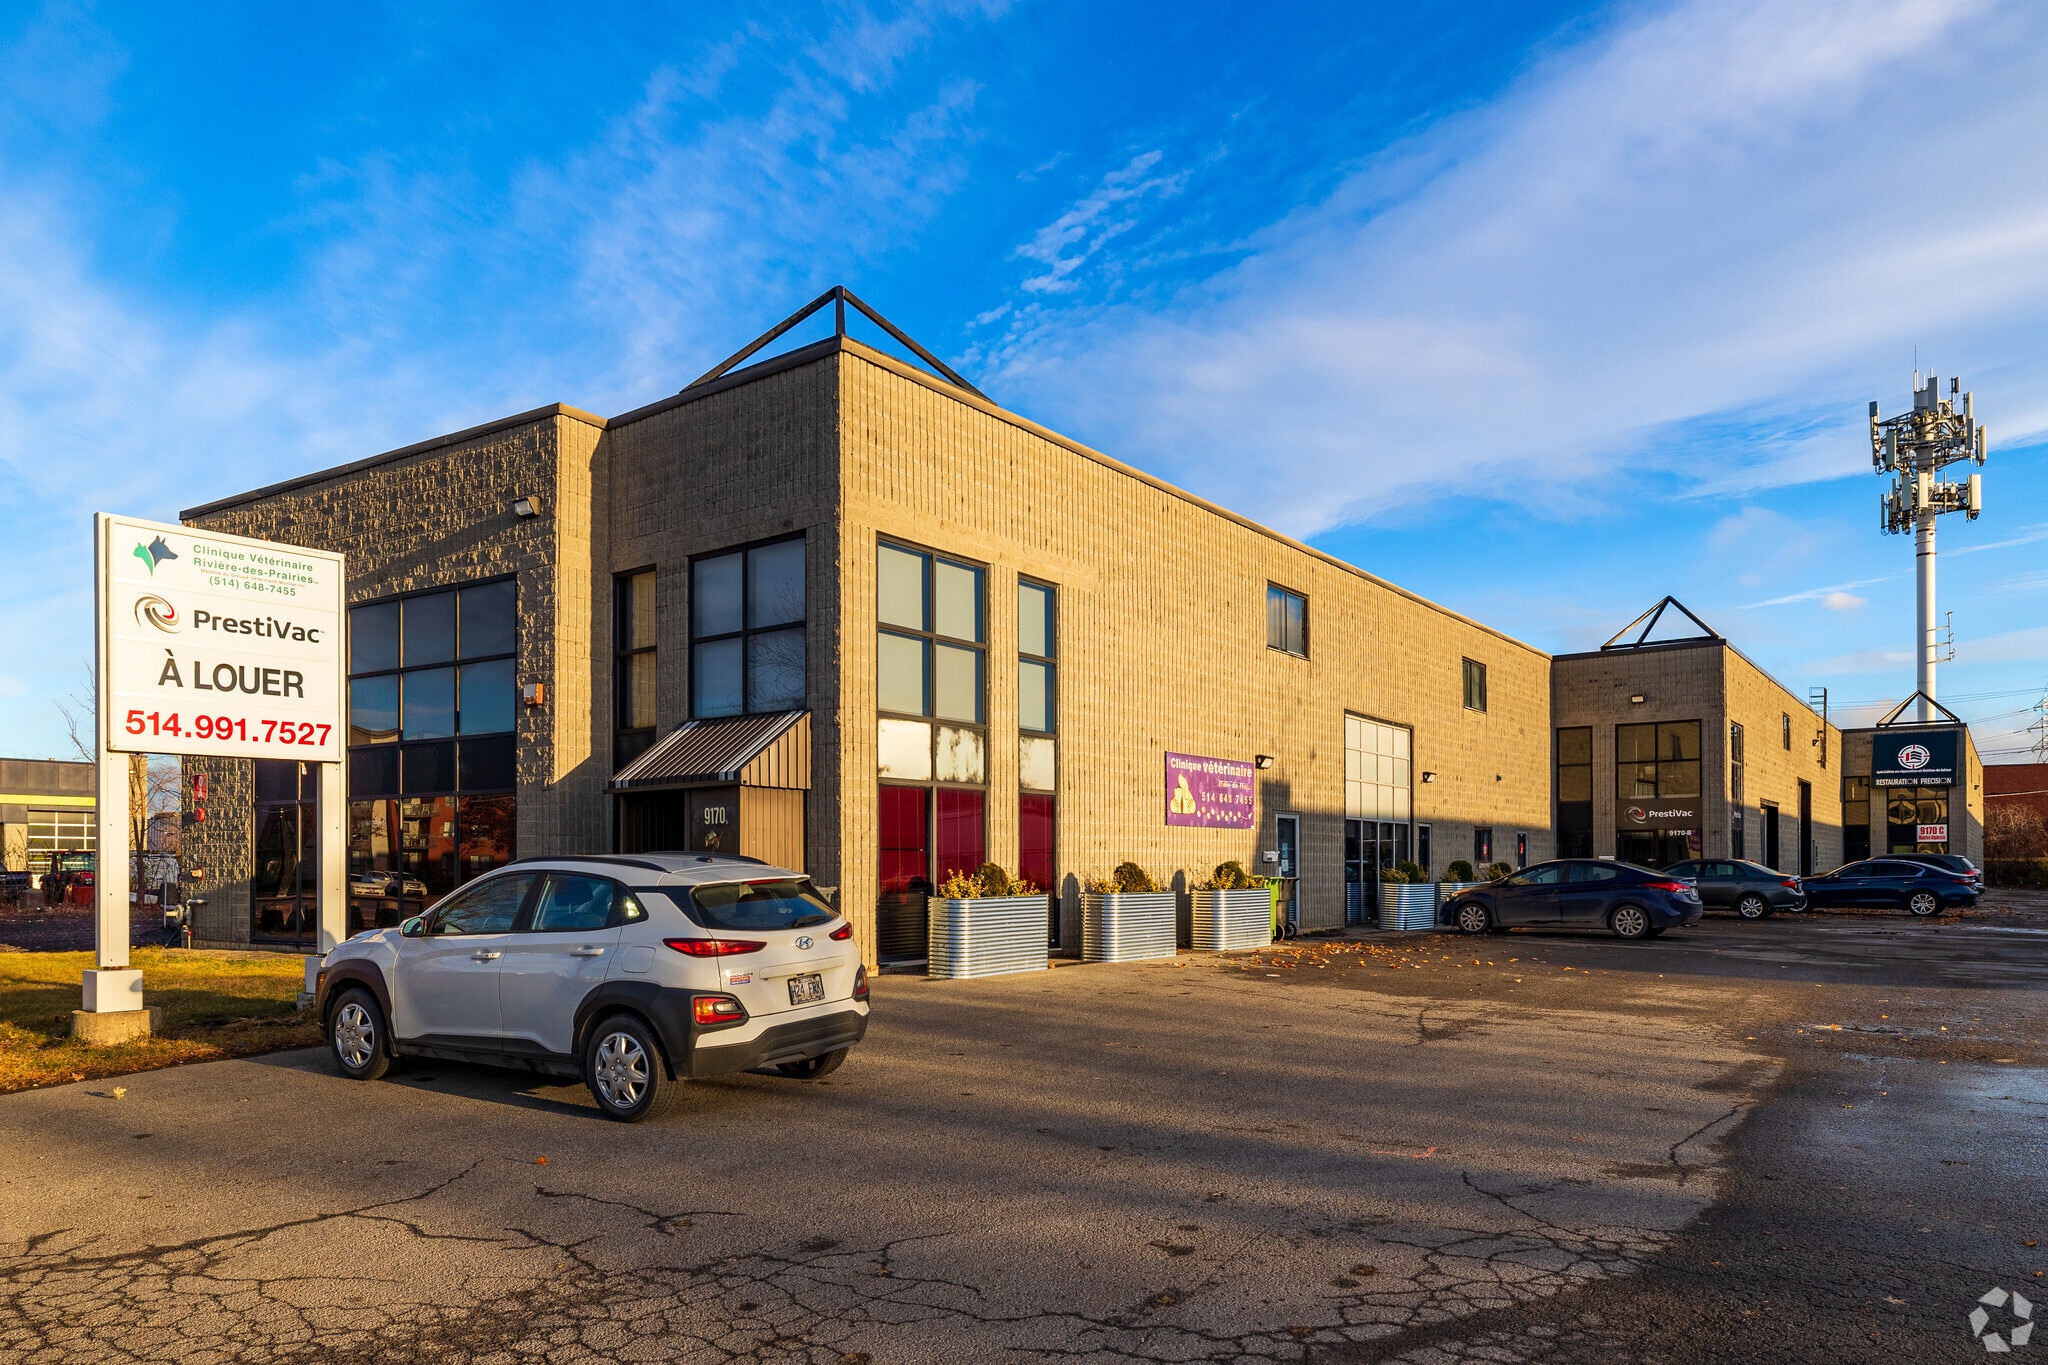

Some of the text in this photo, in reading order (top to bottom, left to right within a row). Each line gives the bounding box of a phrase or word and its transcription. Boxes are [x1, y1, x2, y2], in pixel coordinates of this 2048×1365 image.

[193, 544, 313, 572] Clinique Vétérinaire
[193, 557, 314, 584] Rivière-des-Prairies
[209, 576, 296, 597] (514) 648-7455
[193, 609, 320, 643] PrestiVac
[158, 648, 305, 698] À LOUER
[125, 709, 332, 746] 514.991.7527
[1170, 757, 1253, 778] Clinique vétérinaire
[1875, 777, 1952, 786] RESTAURATION PRECISION
[1201, 792, 1216, 802] 514
[1235, 795, 1253, 805] 7455
[704, 807, 726, 825] 9170
[1649, 809, 1693, 818] PrestiVac
[1920, 826, 1945, 835] 9170 C
